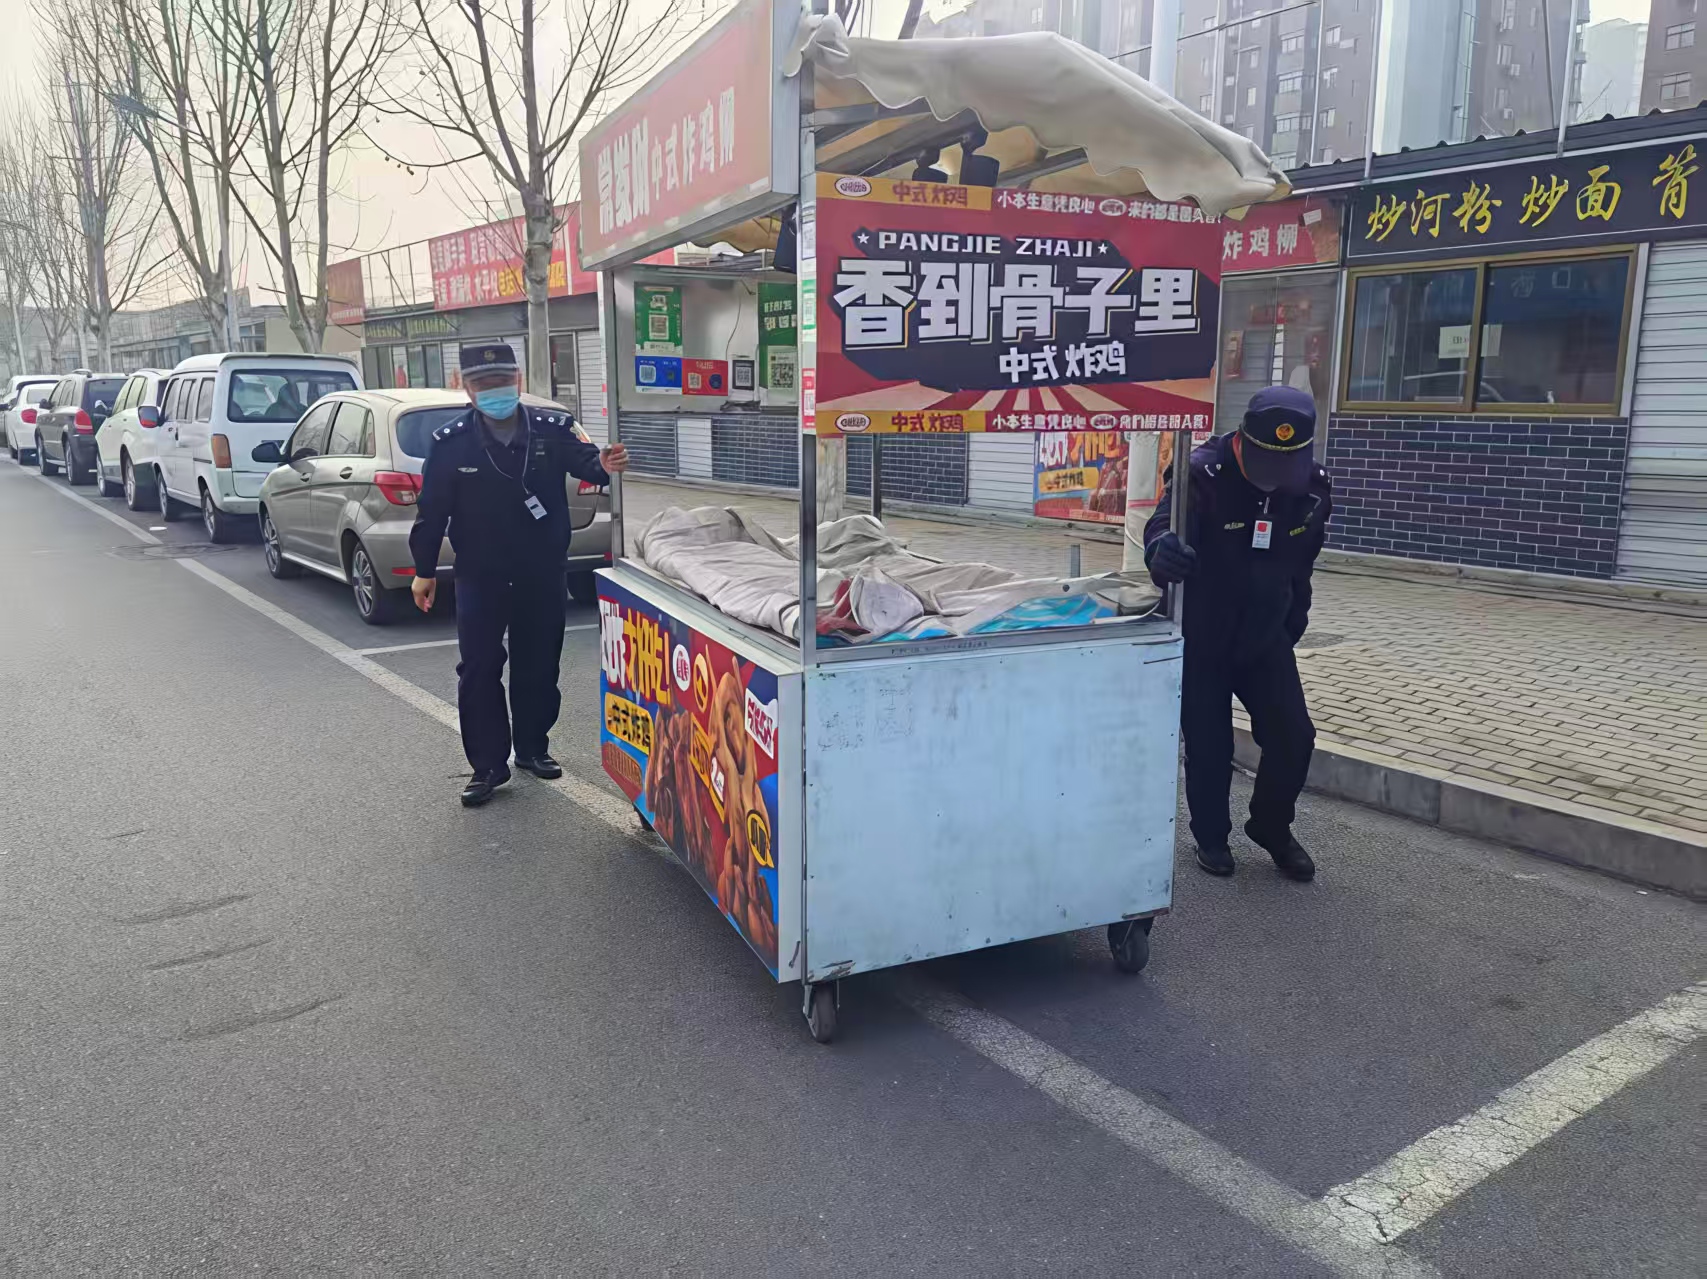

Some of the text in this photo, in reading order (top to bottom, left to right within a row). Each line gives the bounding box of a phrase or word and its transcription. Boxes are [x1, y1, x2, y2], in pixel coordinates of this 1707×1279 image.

[1365, 179, 1502, 242] 炒河粉
[1519, 165, 1622, 227] 炒面
[878, 231, 1093, 258] PANGJIE ZHAJI
[833, 259, 1200, 350] 香到骨子里
[999, 340, 1126, 383] 中式炸鸡
